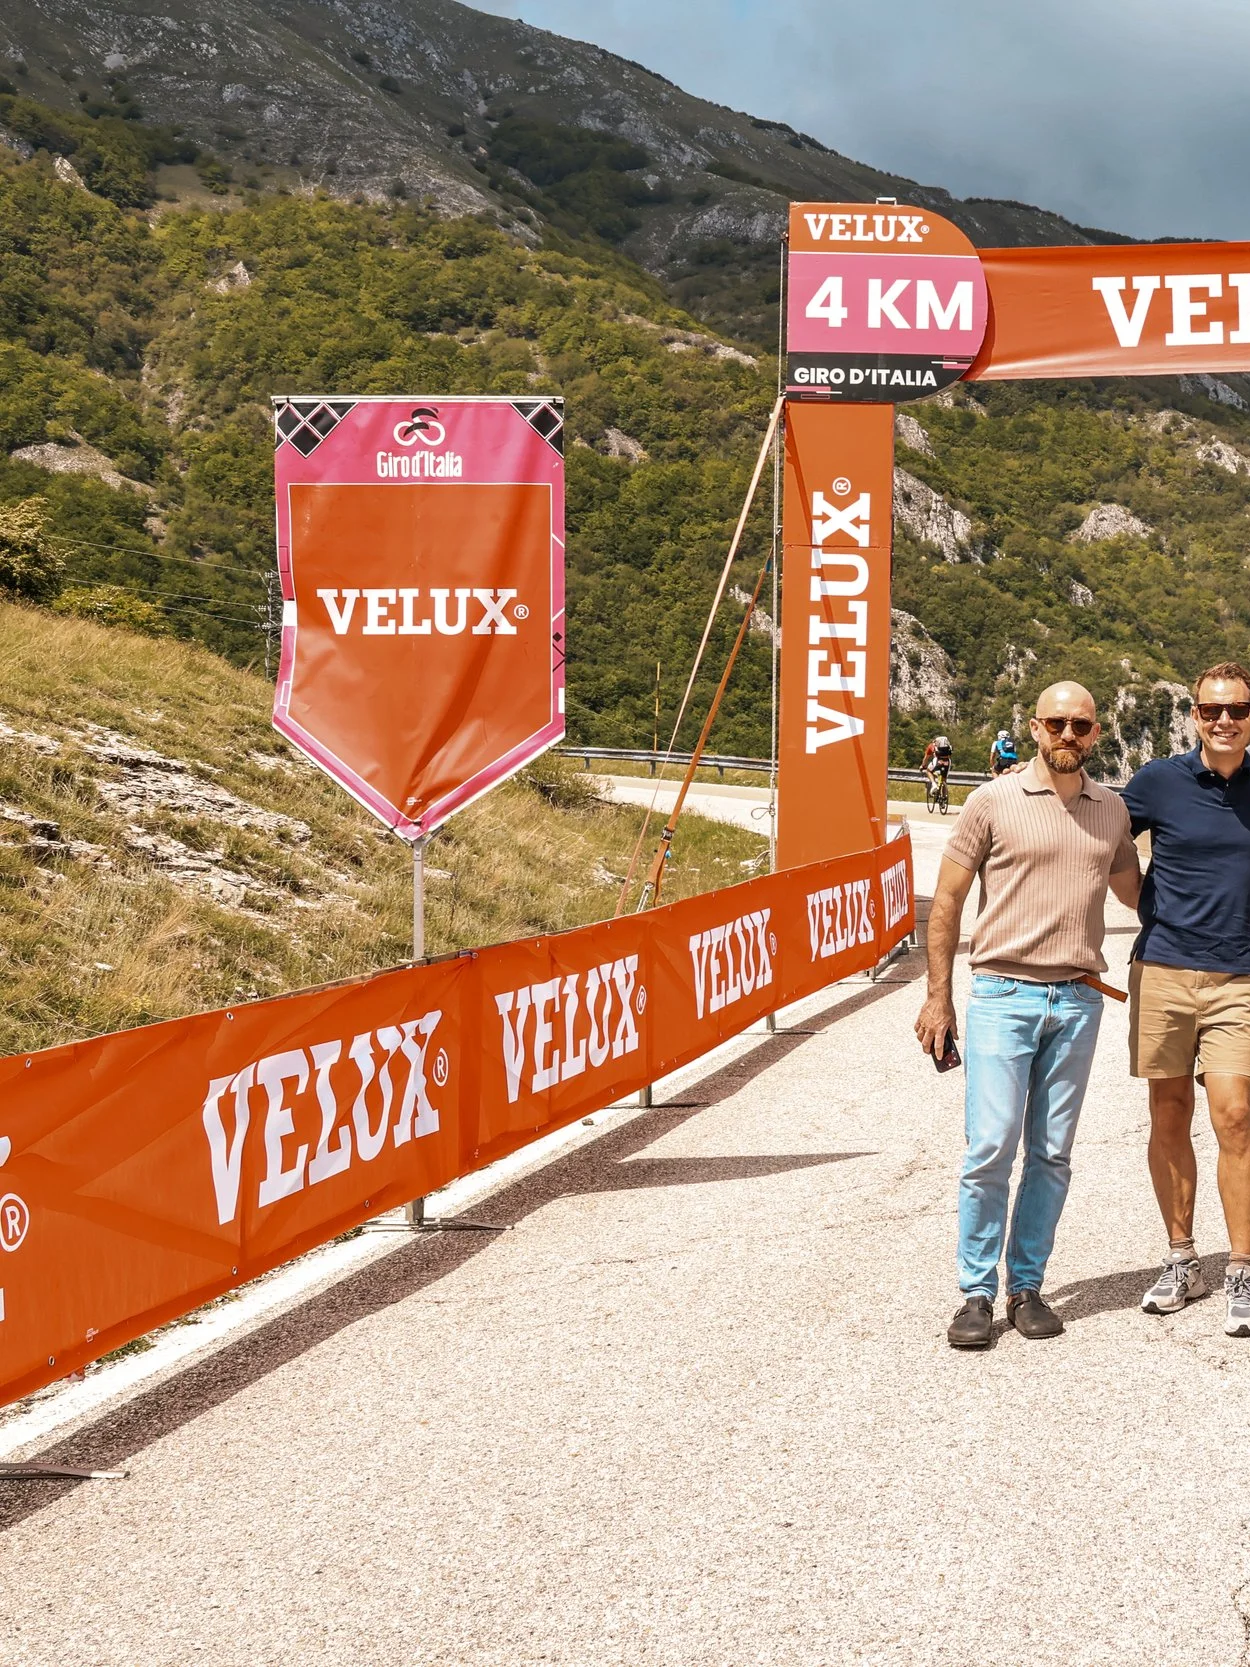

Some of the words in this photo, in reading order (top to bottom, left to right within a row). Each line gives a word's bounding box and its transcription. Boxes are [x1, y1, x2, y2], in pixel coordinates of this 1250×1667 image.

[805, 276, 848, 328] 4
[867, 278, 973, 331] KM
[794, 367, 846, 385] GIRO
[376, 452, 411, 478] Giro
